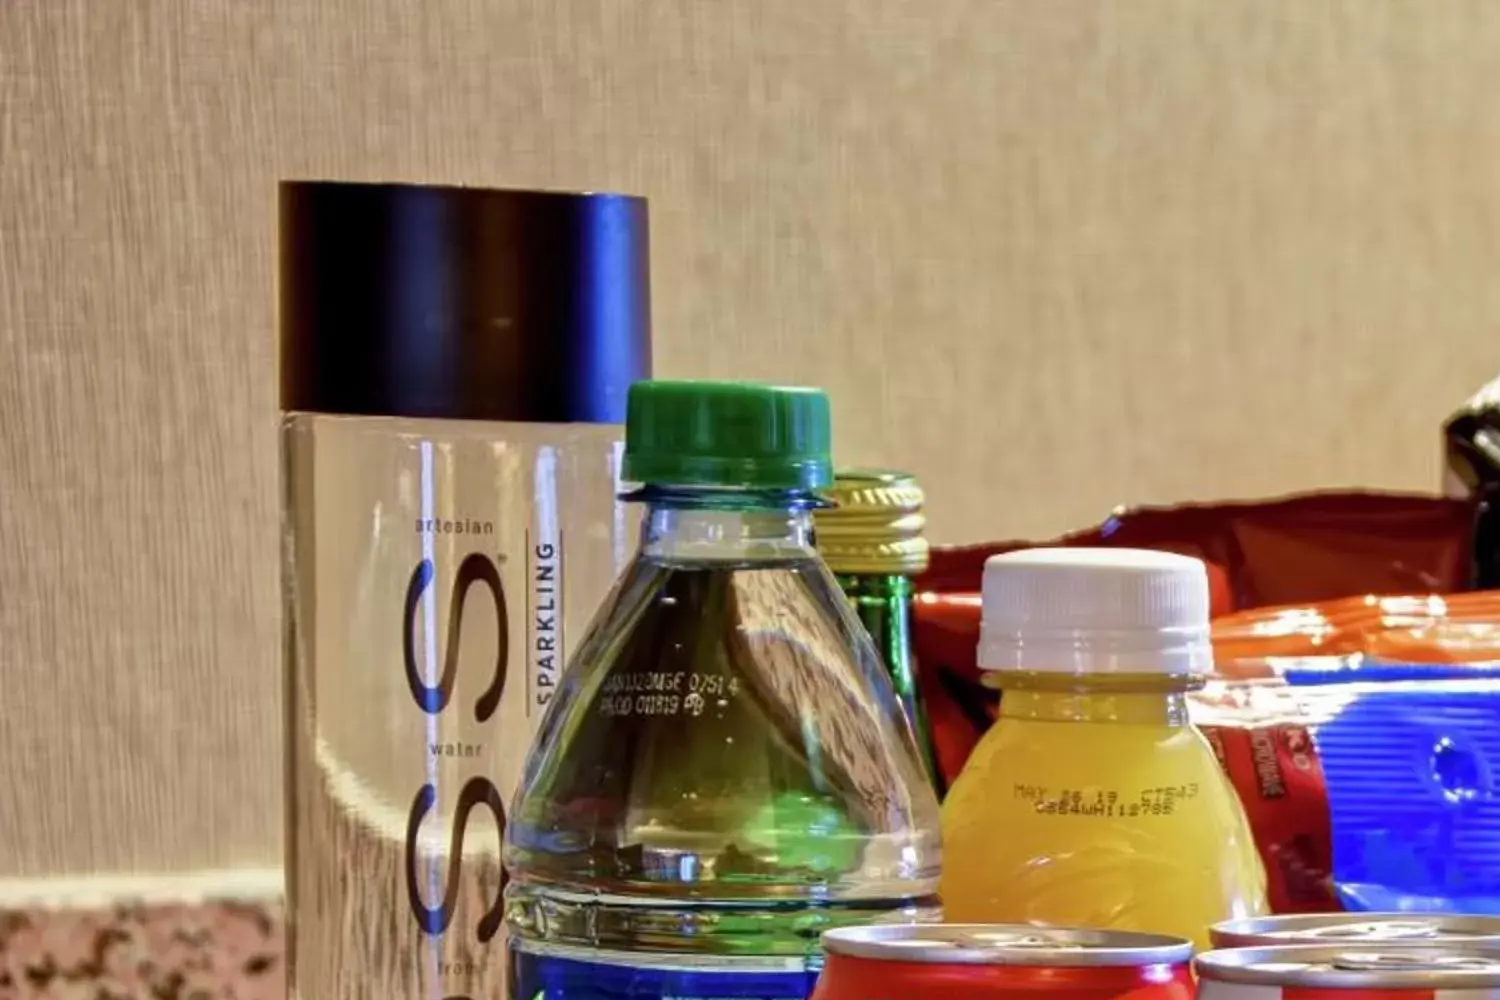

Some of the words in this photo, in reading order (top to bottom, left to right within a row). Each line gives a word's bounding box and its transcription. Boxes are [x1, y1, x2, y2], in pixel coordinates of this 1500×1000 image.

[415, 518, 494, 535] artesian
[535, 542, 557, 705] SPARKLING
[430, 742, 483, 758] water
